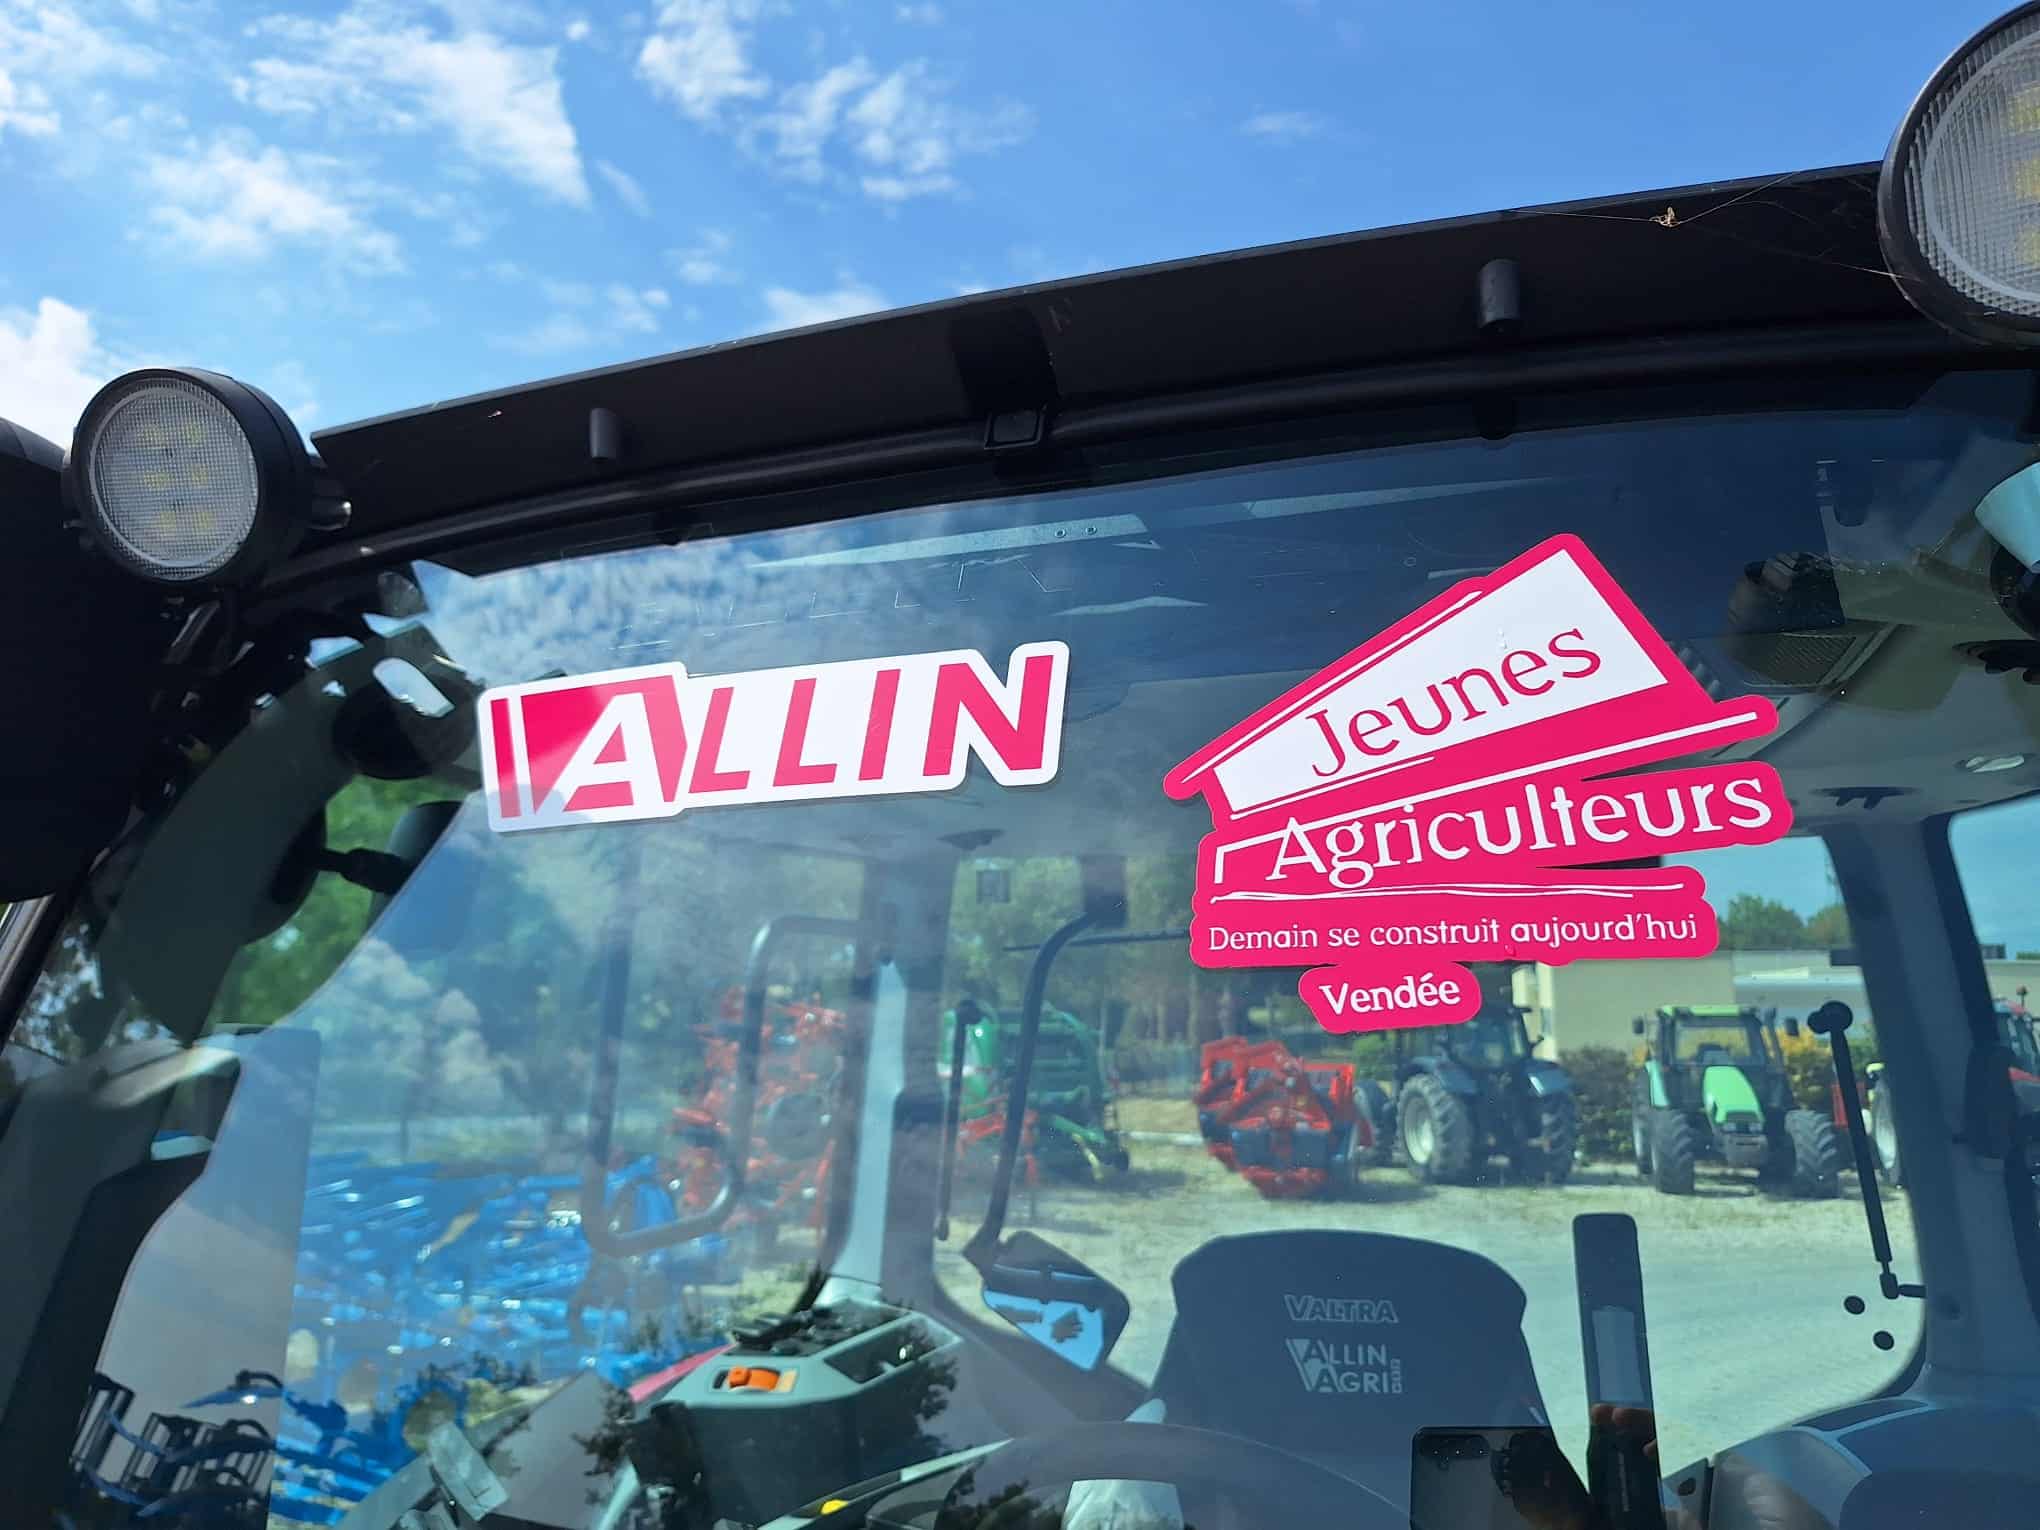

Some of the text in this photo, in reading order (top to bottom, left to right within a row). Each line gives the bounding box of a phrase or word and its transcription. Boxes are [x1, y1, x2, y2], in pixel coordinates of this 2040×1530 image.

[1306, 627, 1602, 776] Jeunes
[1265, 779, 1773, 889] Agriculteurs
[1208, 913, 1698, 950] Demain se construit aujourd'hui
[1319, 972, 1461, 1015] Vendée
[1284, 1294, 1399, 1323] VALTRA
